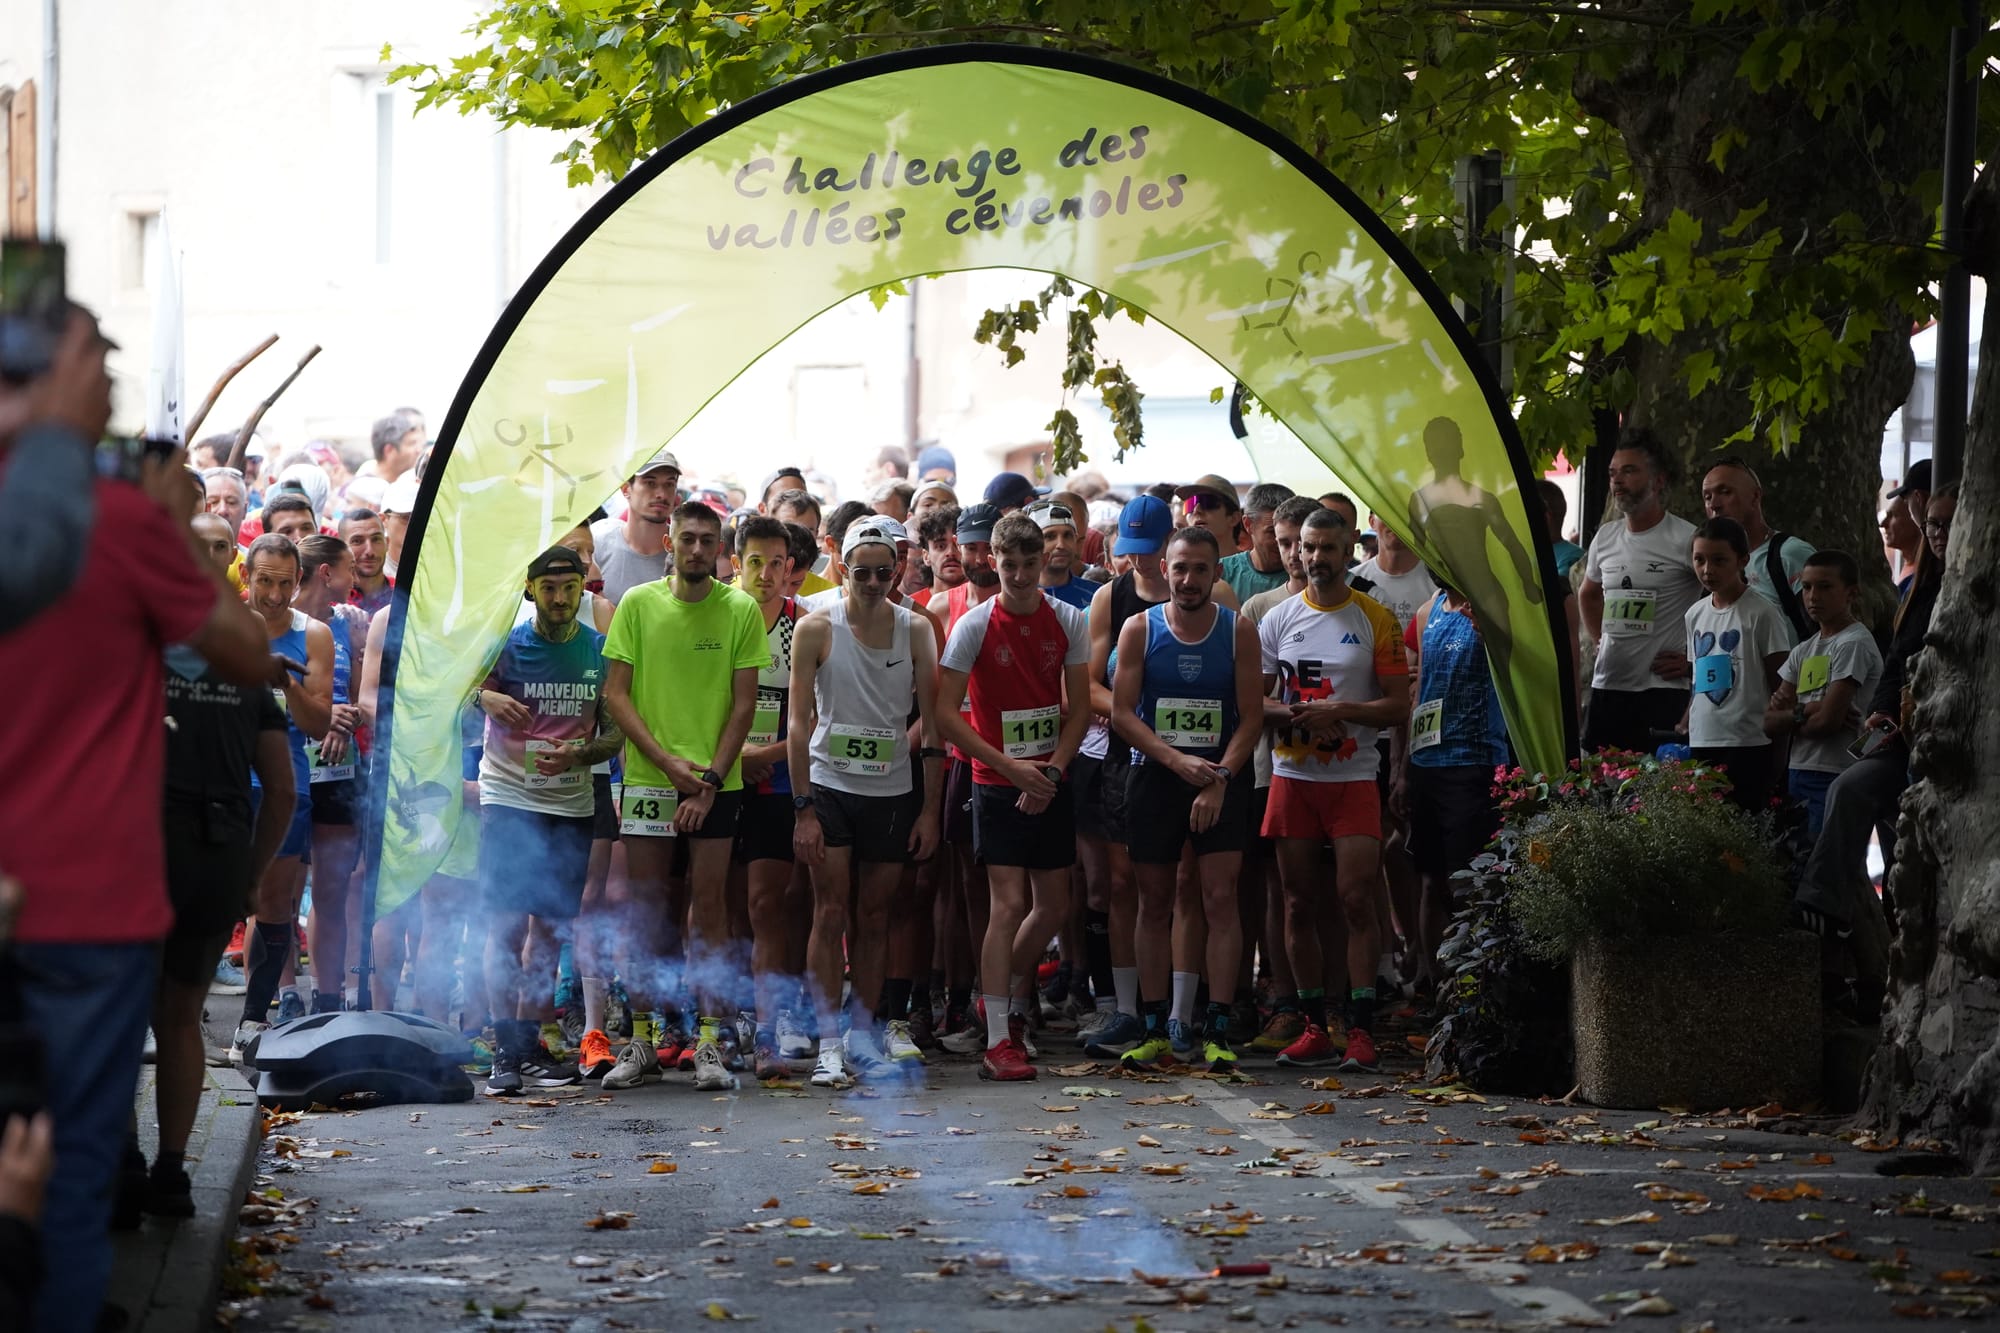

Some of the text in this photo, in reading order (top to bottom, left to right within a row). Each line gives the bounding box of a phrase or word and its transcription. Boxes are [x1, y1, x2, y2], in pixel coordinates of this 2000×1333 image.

[733, 124, 1151, 199] Challenge des
[706, 173, 1188, 252] vallées cévenoles
[1610, 601, 1647, 619] 117
[1706, 669, 1717, 683] 5
[1807, 671, 1813, 685] 1
[523, 682, 597, 701] MARVEJOLS
[537, 699, 584, 717] MENDE
[1013, 719, 1054, 742] 113
[1165, 710, 1214, 731] 134
[1413, 712, 1436, 737] 187
[846, 738, 878, 760] 53
[632, 799, 660, 820] 43
